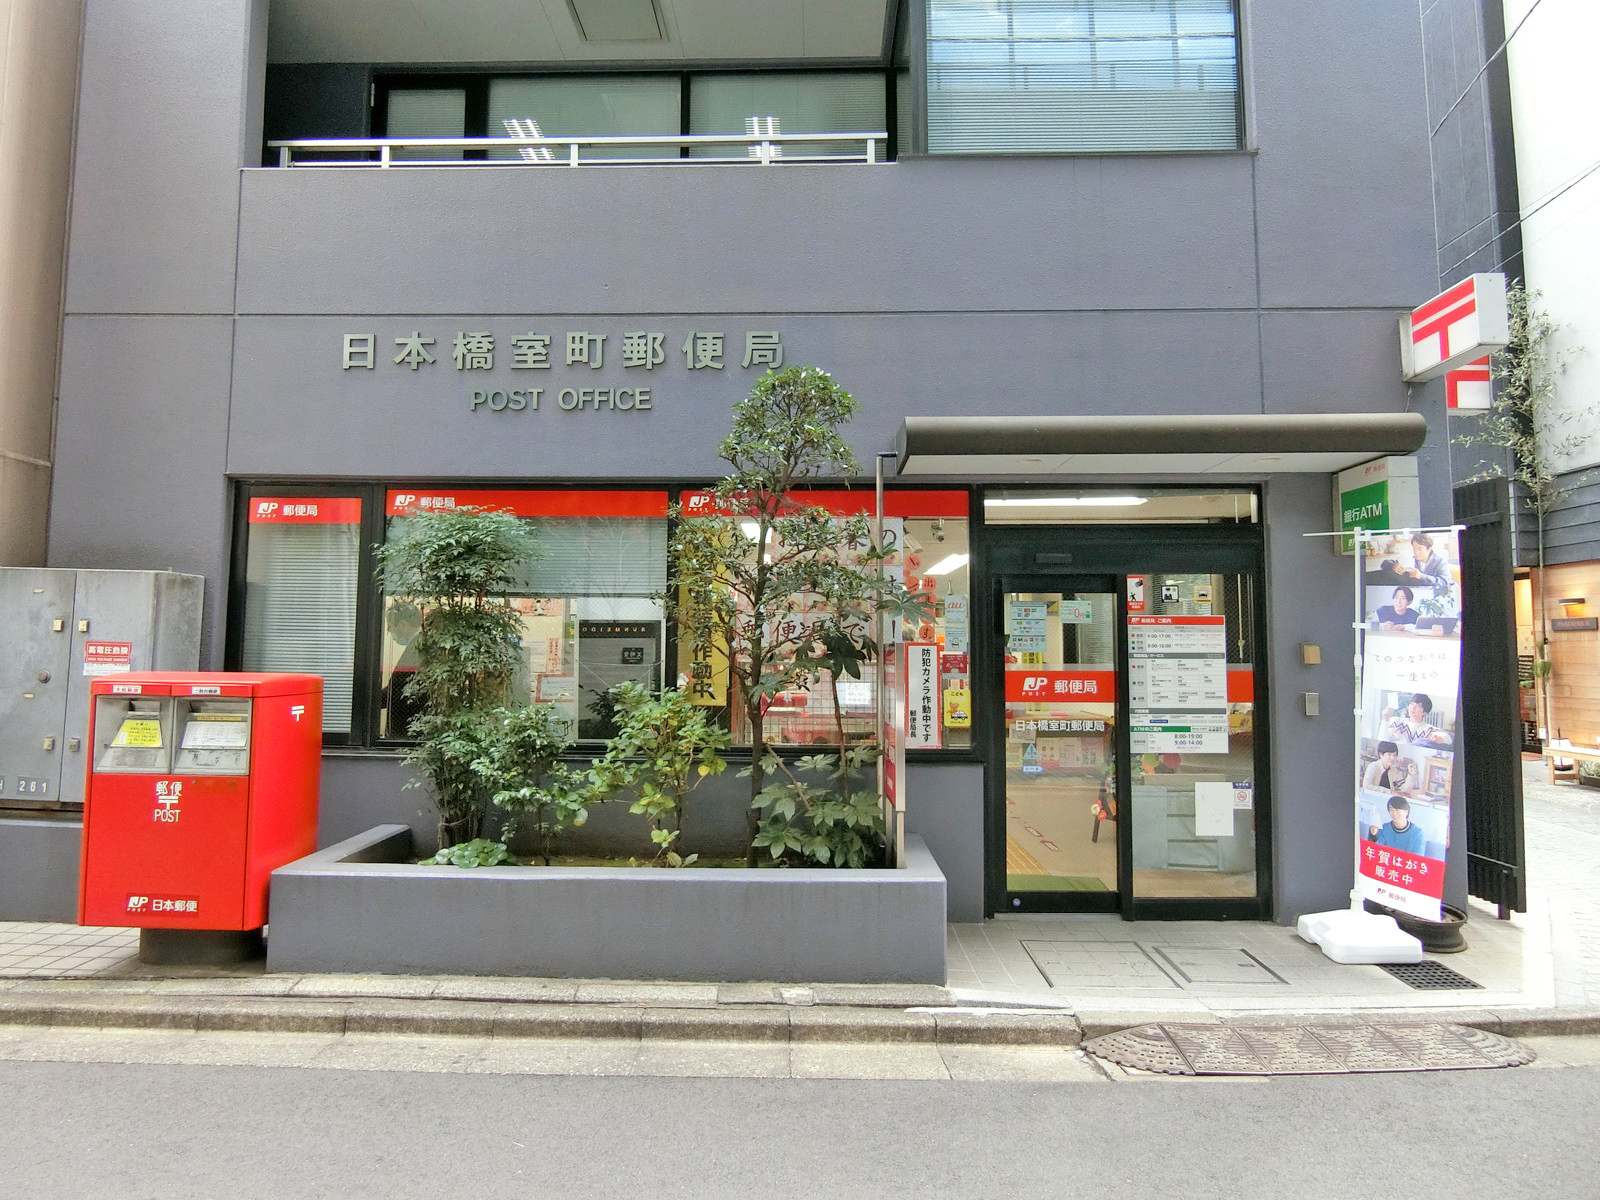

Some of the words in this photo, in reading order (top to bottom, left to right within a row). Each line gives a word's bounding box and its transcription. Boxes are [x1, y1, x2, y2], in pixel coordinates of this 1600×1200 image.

[342, 330, 785, 370] 日本橋室町郵便局
[470, 387, 544, 411] POST
[557, 387, 652, 410] OFFICE
[420, 496, 456, 509] 郵便局
[282, 504, 318, 517] 郵便局
[1343, 502, 1383, 523] 銀行ATM
[1054, 680, 1097, 694] 郵便局
[921, 648, 931, 742] 防犯カメラ作動中です
[1015, 719, 1105, 732] 日本橋室町郵便局
[19, 780, 47, 793] 261
[155, 780, 183, 797] 郵便
[153, 809, 181, 823] POST
[1365, 845, 1429, 876] 年賀はがき
[1375, 864, 1413, 885] 販売中
[152, 899, 198, 912] 日本郵便
